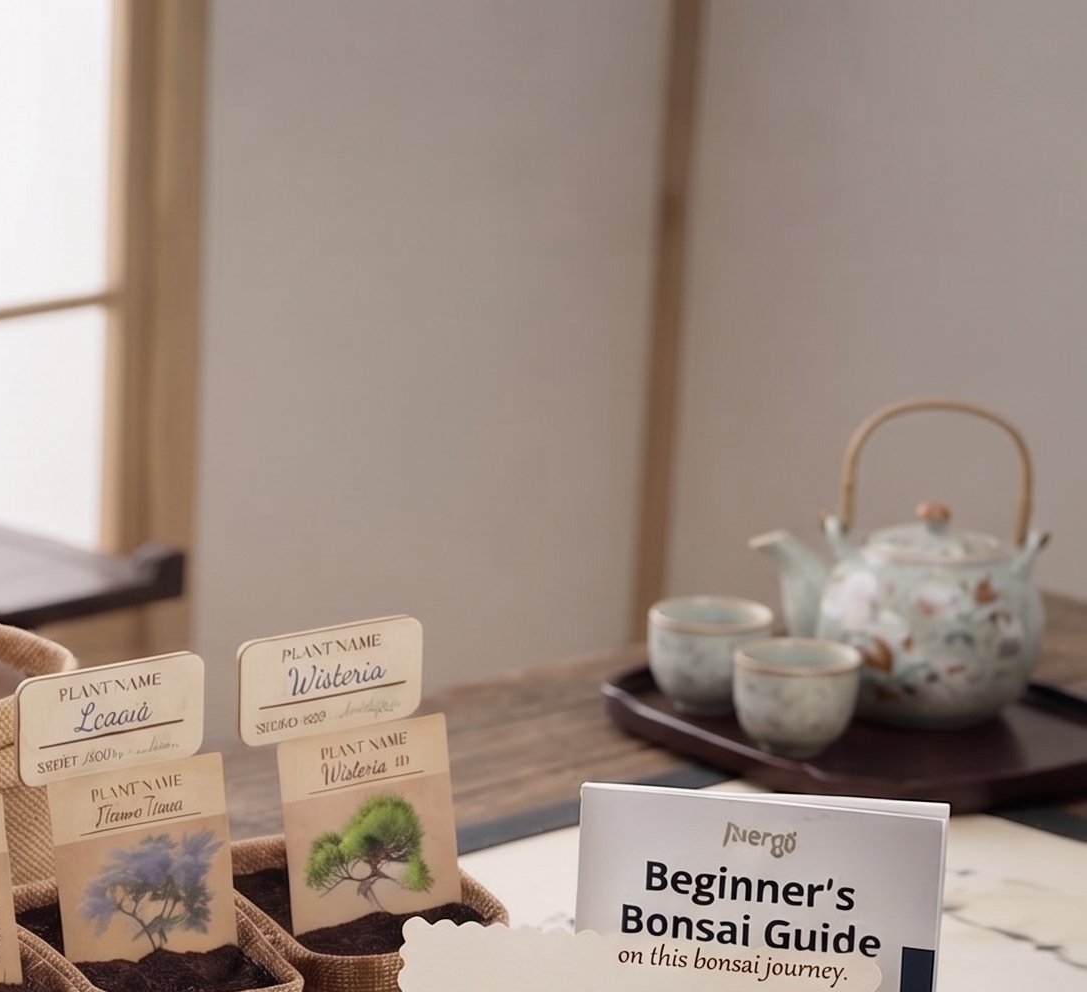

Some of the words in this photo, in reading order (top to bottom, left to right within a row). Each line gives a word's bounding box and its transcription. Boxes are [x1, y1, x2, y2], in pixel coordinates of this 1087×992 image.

[282, 641, 333, 663] PLANT
[336, 633, 382, 652] NAME
[59, 680, 113, 702] PLANT
[114, 672, 162, 692] NAME
[288, 662, 387, 697] Wisteria
[321, 740, 366, 761] PLANT
[369, 731, 408, 751] NAME
[91, 781, 140, 803] PLANT
[645, 860, 856, 911] Beginner's
[621, 903, 751, 947] Bonsai
[764, 919, 882, 958] Guide
[618, 949, 643, 965] on
[650, 943, 688, 968] this
[693, 947, 761, 974] bonsai
[757, 957, 848, 988] journey.
